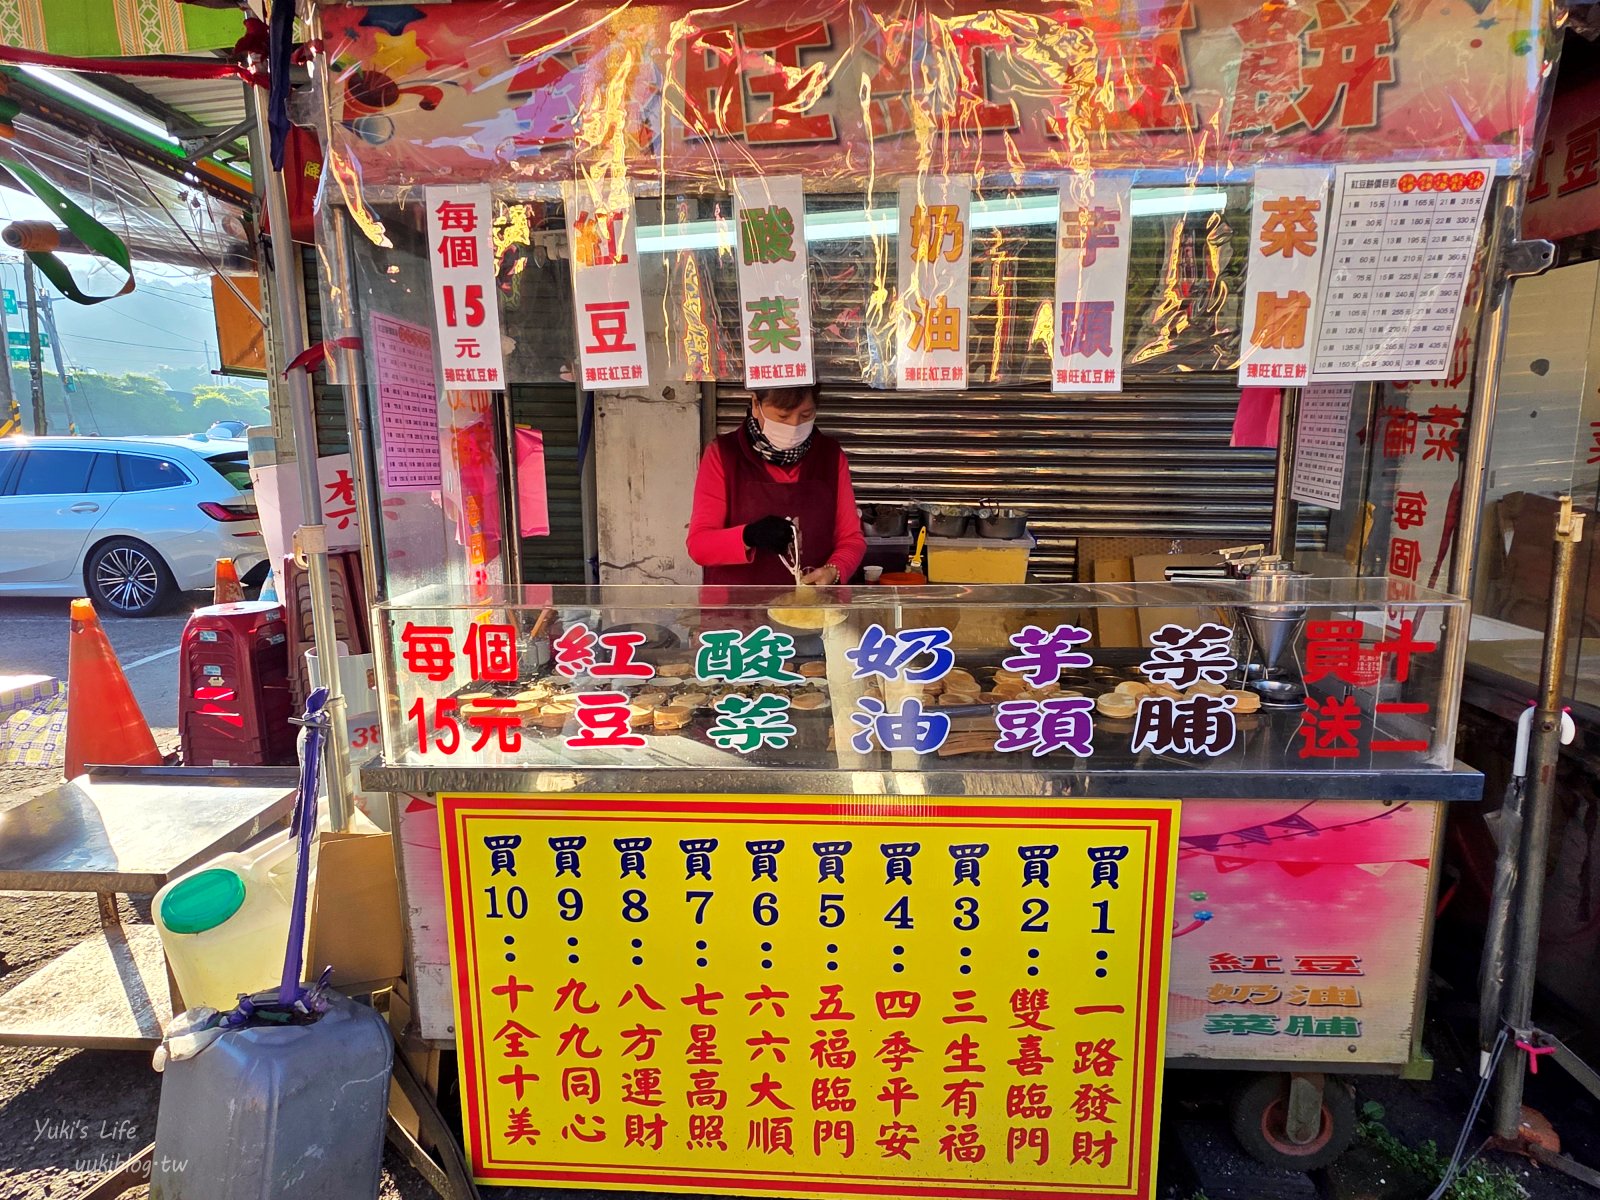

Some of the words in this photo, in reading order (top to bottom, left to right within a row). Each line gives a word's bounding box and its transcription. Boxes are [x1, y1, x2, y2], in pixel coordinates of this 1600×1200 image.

[907, 205, 964, 353] 奶油
[401, 621, 519, 683] 每個
[554, 622, 656, 750] 紅豆
[695, 624, 805, 754] 酸菜
[843, 623, 955, 755] 奶油
[993, 624, 1094, 757] 芋頭
[1131, 623, 1238, 757] 菜脯
[1304, 619, 1437, 685] 買十
[407, 697, 522, 756] 15元
[1300, 696, 1431, 759] 送二
